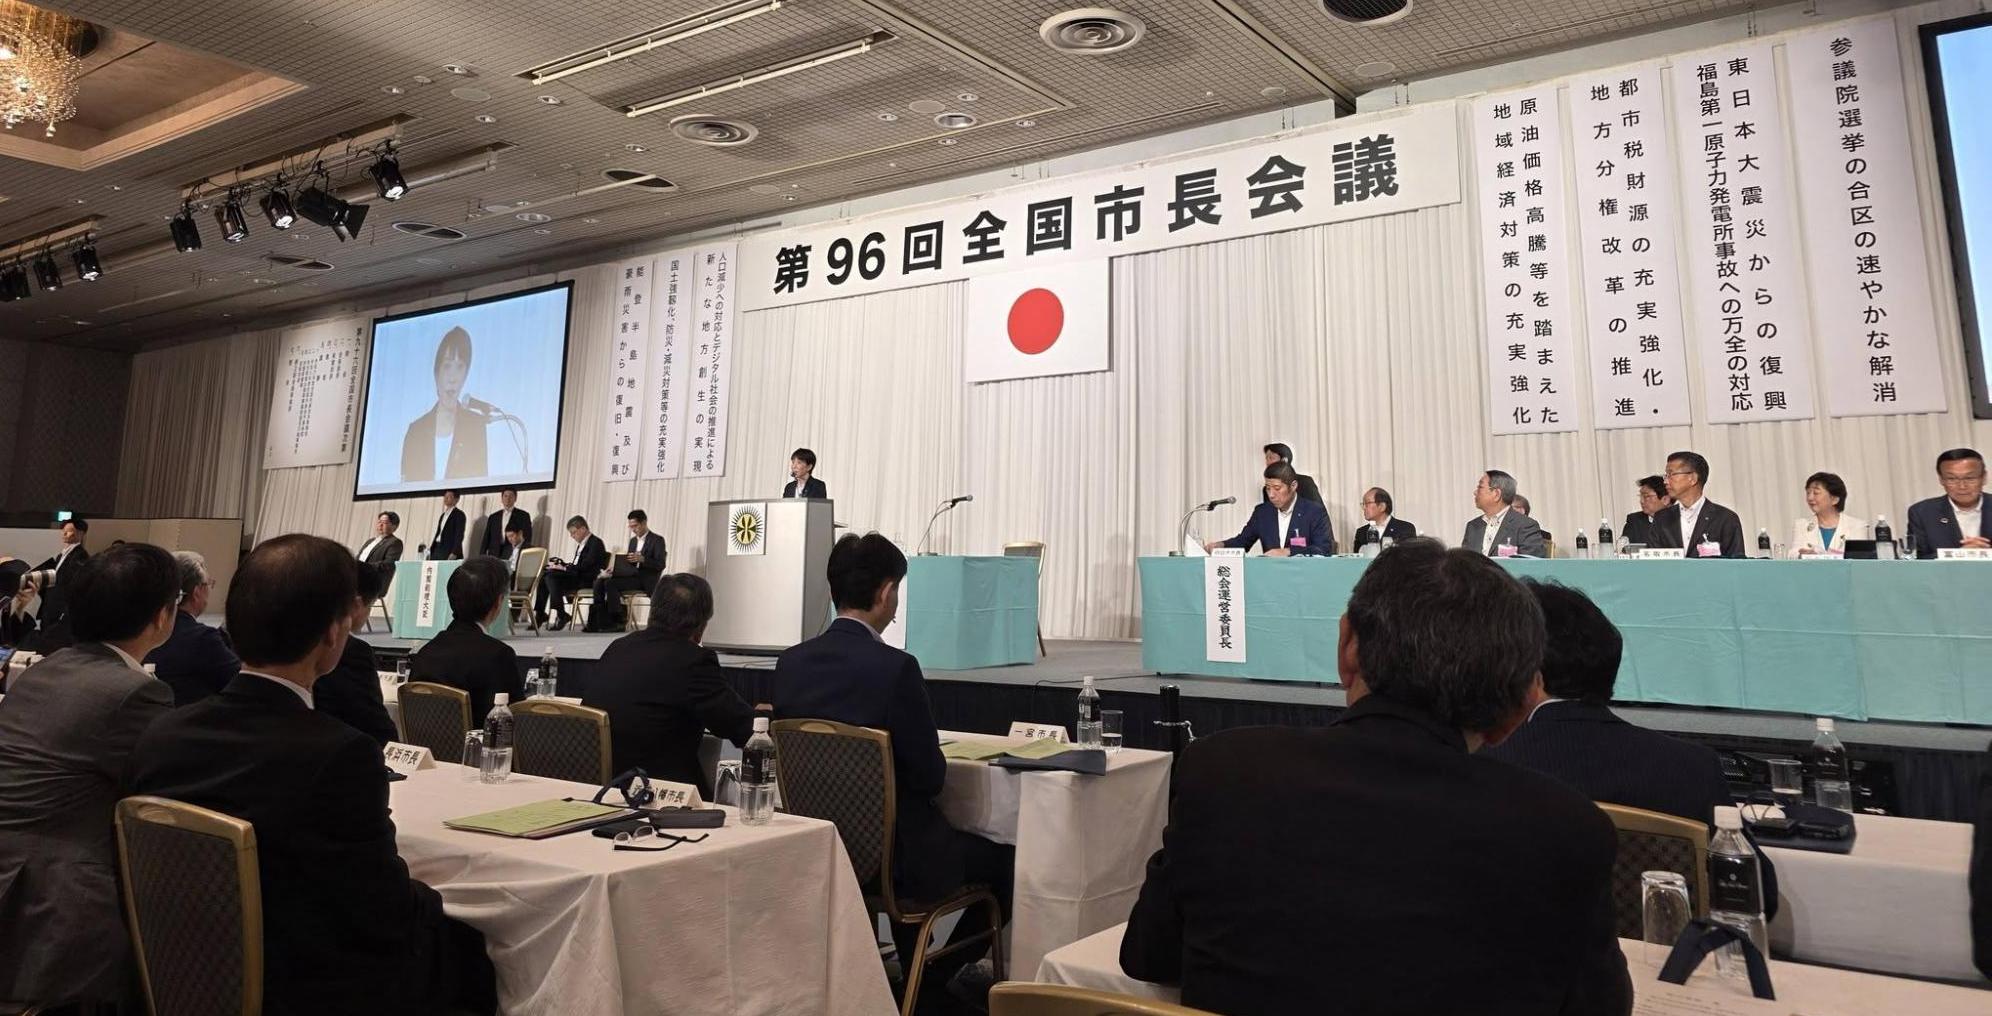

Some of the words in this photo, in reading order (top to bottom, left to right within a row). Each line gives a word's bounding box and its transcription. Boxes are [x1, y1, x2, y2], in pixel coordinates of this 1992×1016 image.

[622, 265, 645, 476] 能登半島地震及び
[693, 253, 716, 472] 新たな地方創生の実現
[774, 133, 1400, 296] 第96回全国市長会議
[1493, 104, 1532, 425] 地域経済対策の充実強化
[1519, 97, 1560, 425] 原油価格高騰等を踏まえた
[1590, 84, 1636, 418] 地方分権改革の推進
[1696, 63, 1754, 412] 福島第一原子力発電所事故への万全の対応
[1727, 57, 1787, 411] 東日本大震災からの復興
[1830, 37, 1897, 403] 参議院選挙の合区の速やかな解消
[1217, 565, 1232, 649] 総会運営委員長
